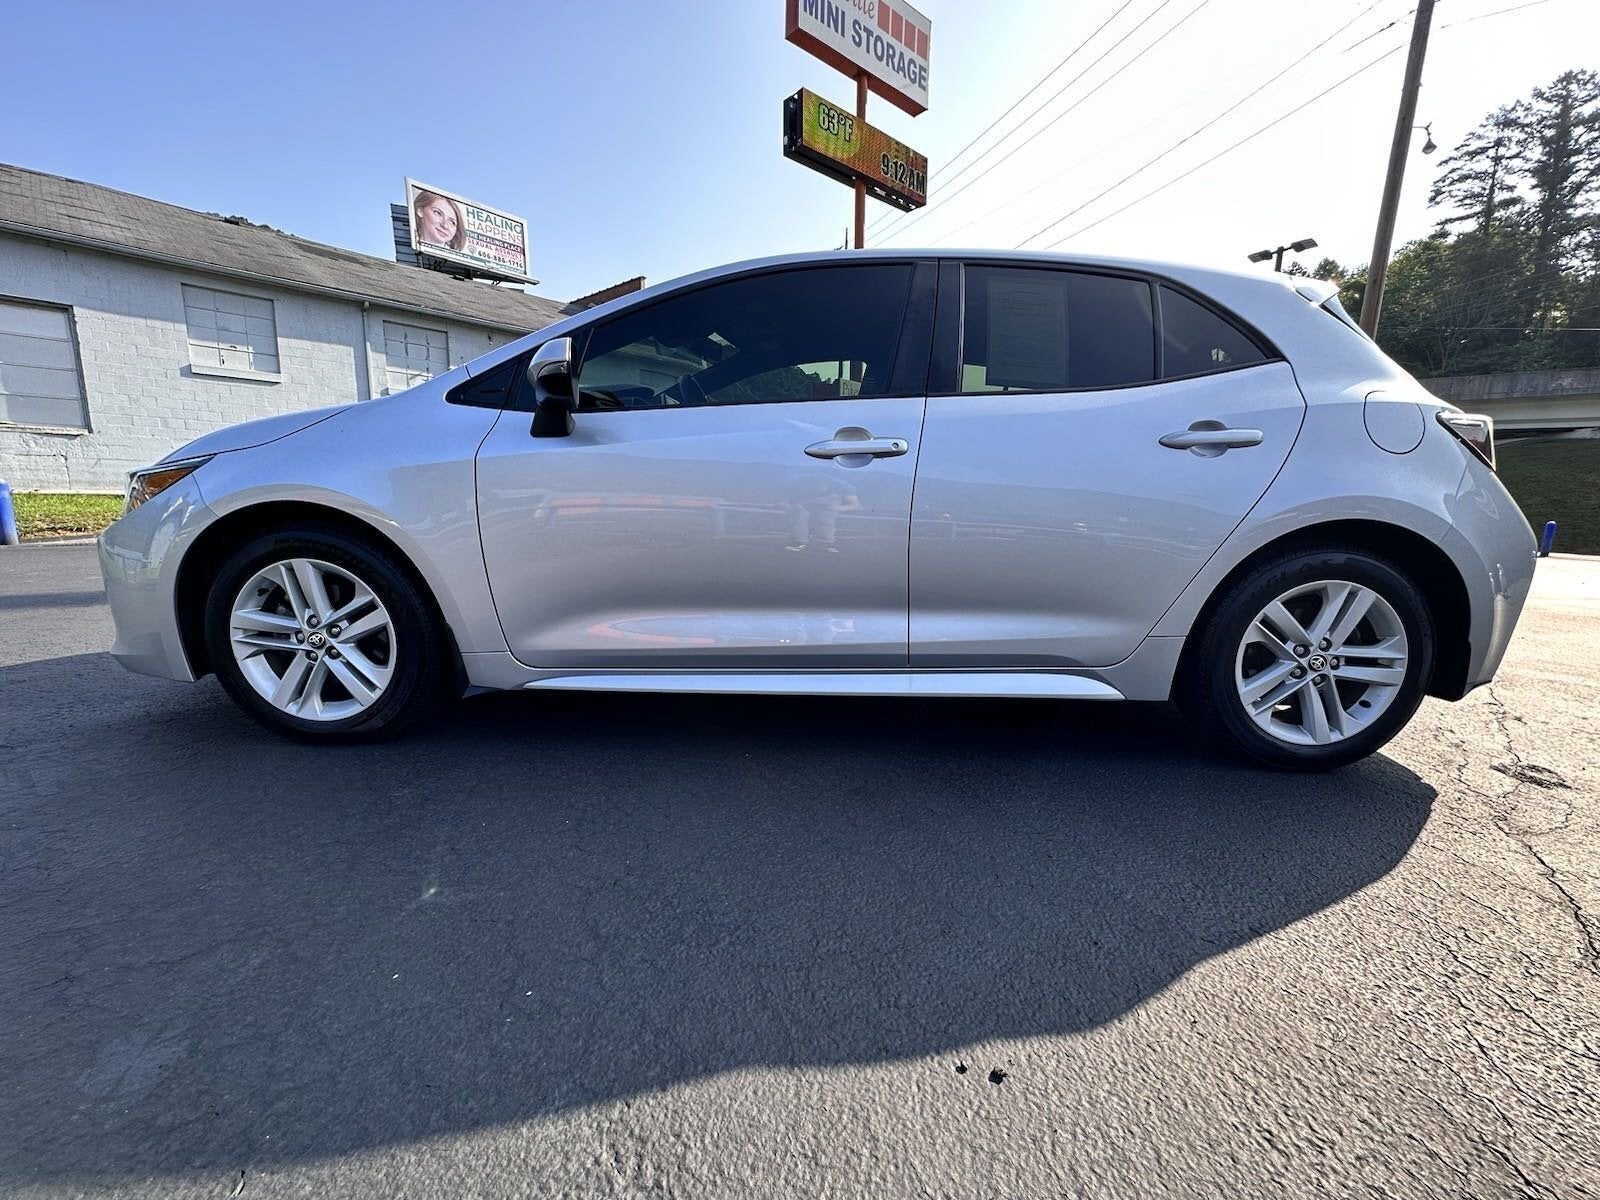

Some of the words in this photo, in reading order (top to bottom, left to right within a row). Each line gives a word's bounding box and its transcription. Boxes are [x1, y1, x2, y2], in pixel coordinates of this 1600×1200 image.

[803, 0, 846, 38] MINI
[852, 19, 926, 91] STORAGE
[818, 103, 853, 142] 63°F
[466, 207, 522, 234] HEALING
[467, 219, 522, 243] HAPPENS
[467, 238, 493, 250] SEXUAL
[495, 247, 521, 258] ASSAULT
[479, 235, 504, 247] HEALING
